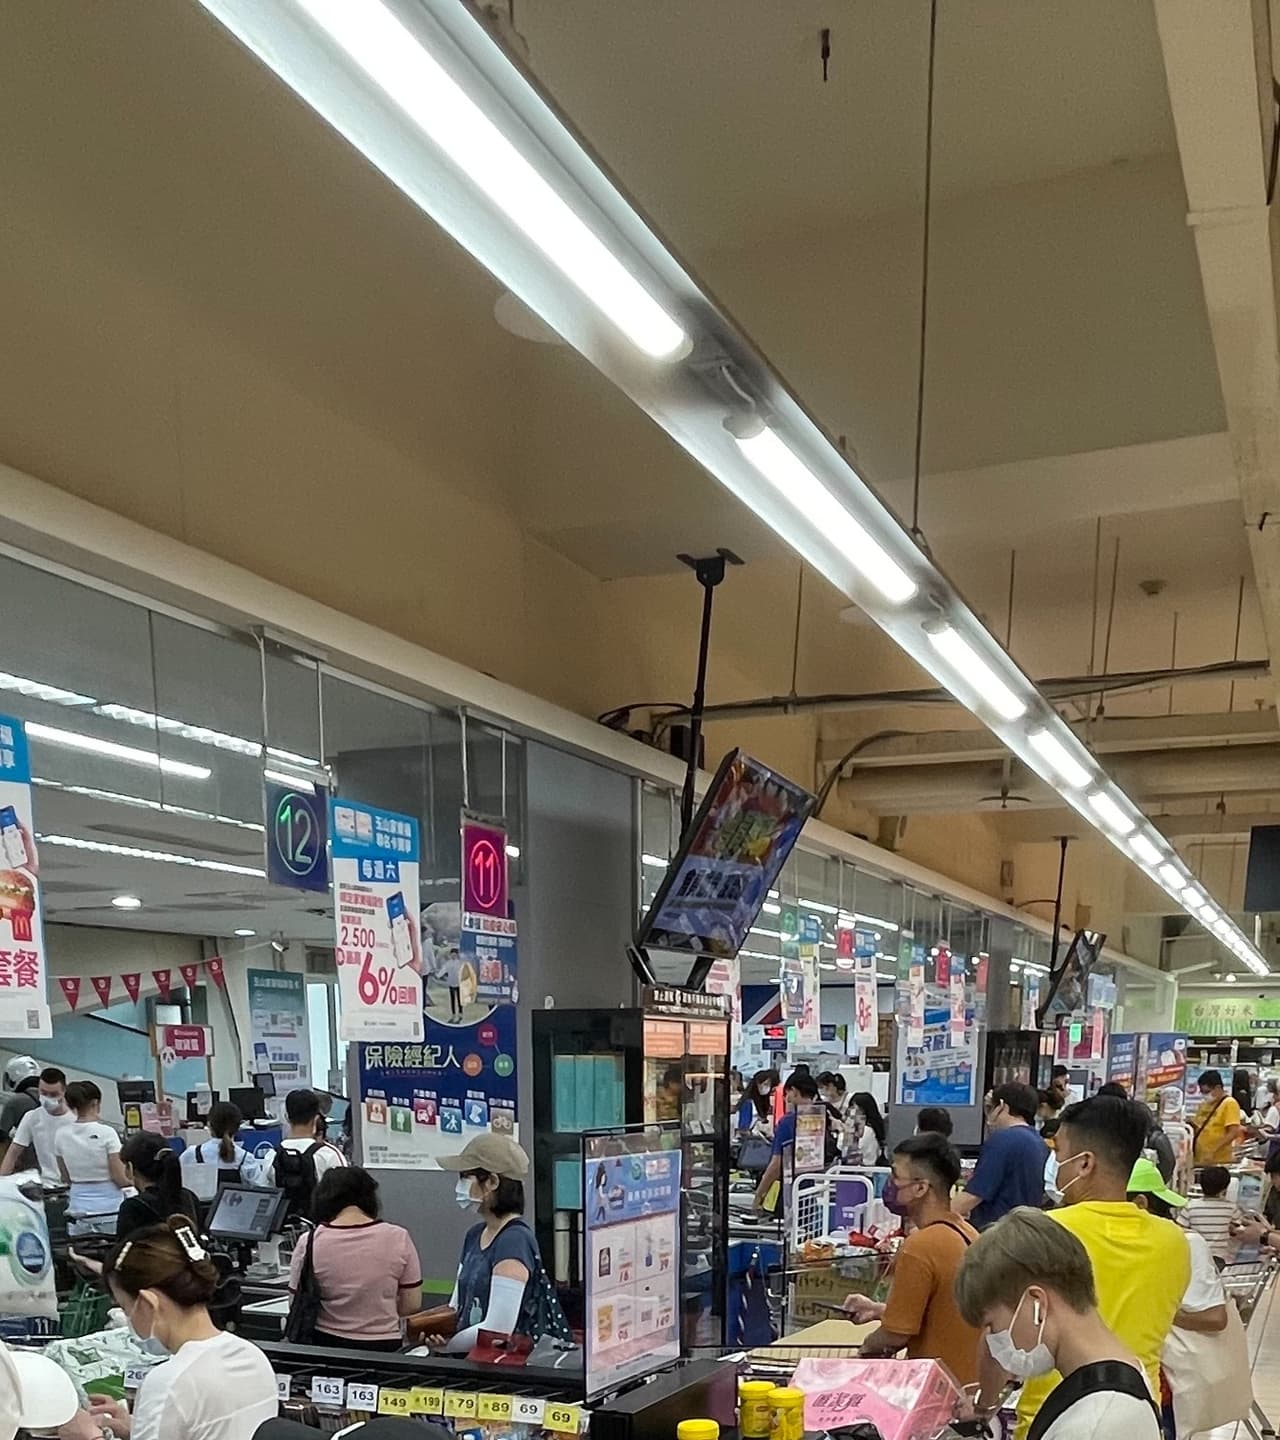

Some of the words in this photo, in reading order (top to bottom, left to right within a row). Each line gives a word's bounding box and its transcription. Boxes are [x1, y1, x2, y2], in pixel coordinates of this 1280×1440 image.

[280, 806, 312, 864] 12
[475, 851, 494, 898] 11
[364, 1045, 461, 1071] 保險經紀人
[315, 1383, 340, 1395] 163
[351, 1390, 374, 1402] 163
[383, 1396, 406, 1408] 149
[423, 1396, 440, 1408] 199
[457, 1398, 474, 1409] 79
[491, 1402, 509, 1413] 89
[520, 1403, 538, 1415] 69
[552, 1411, 570, 1423] 69
